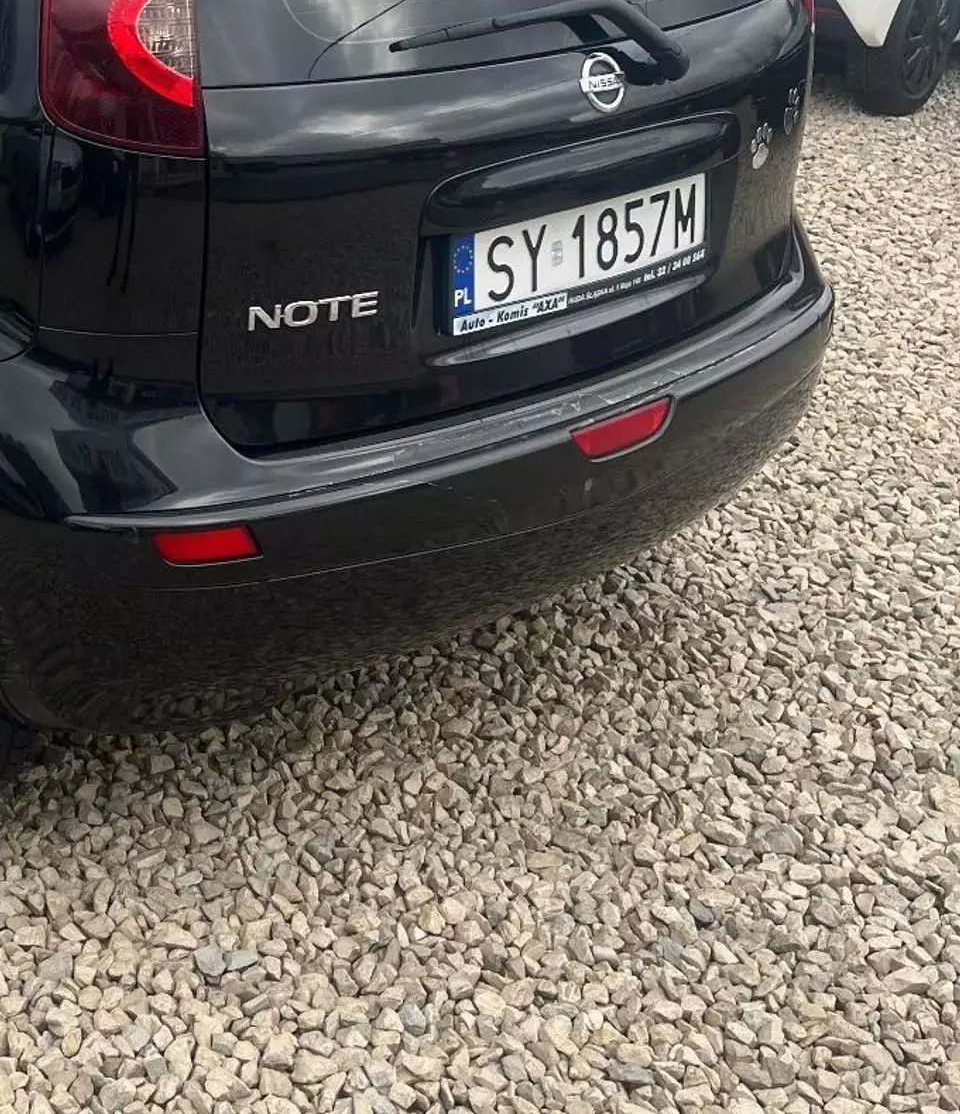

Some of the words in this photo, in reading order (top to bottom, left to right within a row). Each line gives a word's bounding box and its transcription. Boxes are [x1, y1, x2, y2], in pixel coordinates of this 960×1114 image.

[487, 223, 548, 302] SY
[571, 182, 697, 279] 1857M
[247, 290, 379, 332] NOTE
[454, 287, 472, 307] PL
[460, 318, 486, 332] Auto
[497, 304, 529, 323] Komis
